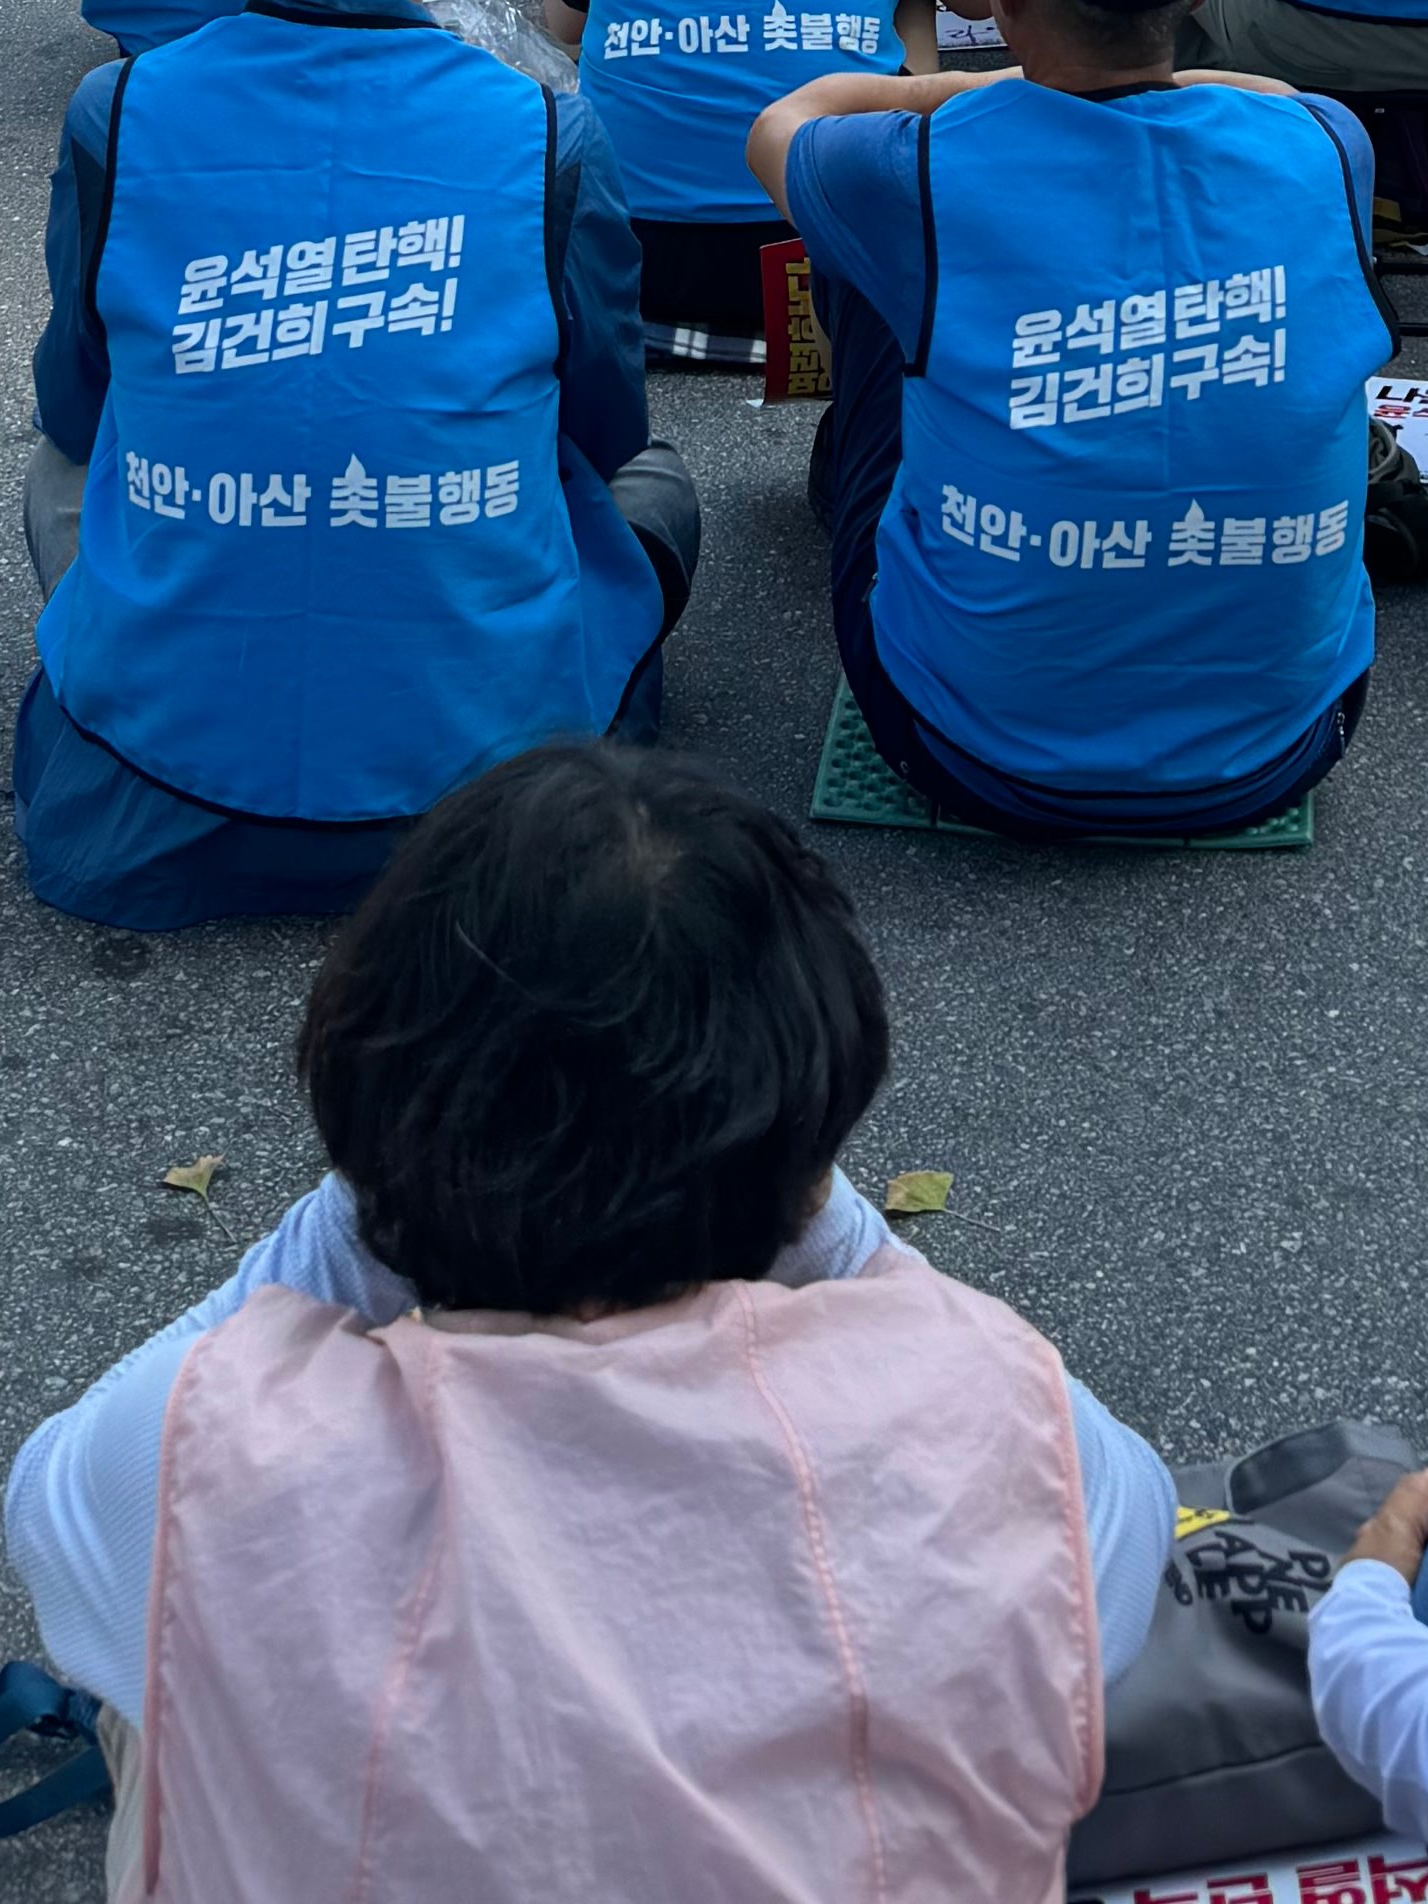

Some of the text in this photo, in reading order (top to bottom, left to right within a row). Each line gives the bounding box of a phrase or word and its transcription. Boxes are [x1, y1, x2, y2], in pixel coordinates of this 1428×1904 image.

[604, 13, 750, 59] 천안·아산
[178, 214, 466, 316] 윤석열 탄핵!
[172, 277, 458, 375] 김건희 구속!
[1012, 264, 1286, 369] 윤석열 탄핵!
[1008, 328, 1286, 431] 김건희 구속!
[125, 450, 520, 529] 천안·아산 촛불행동
[941, 483, 1349, 570] 천안·아산 촛불행동
